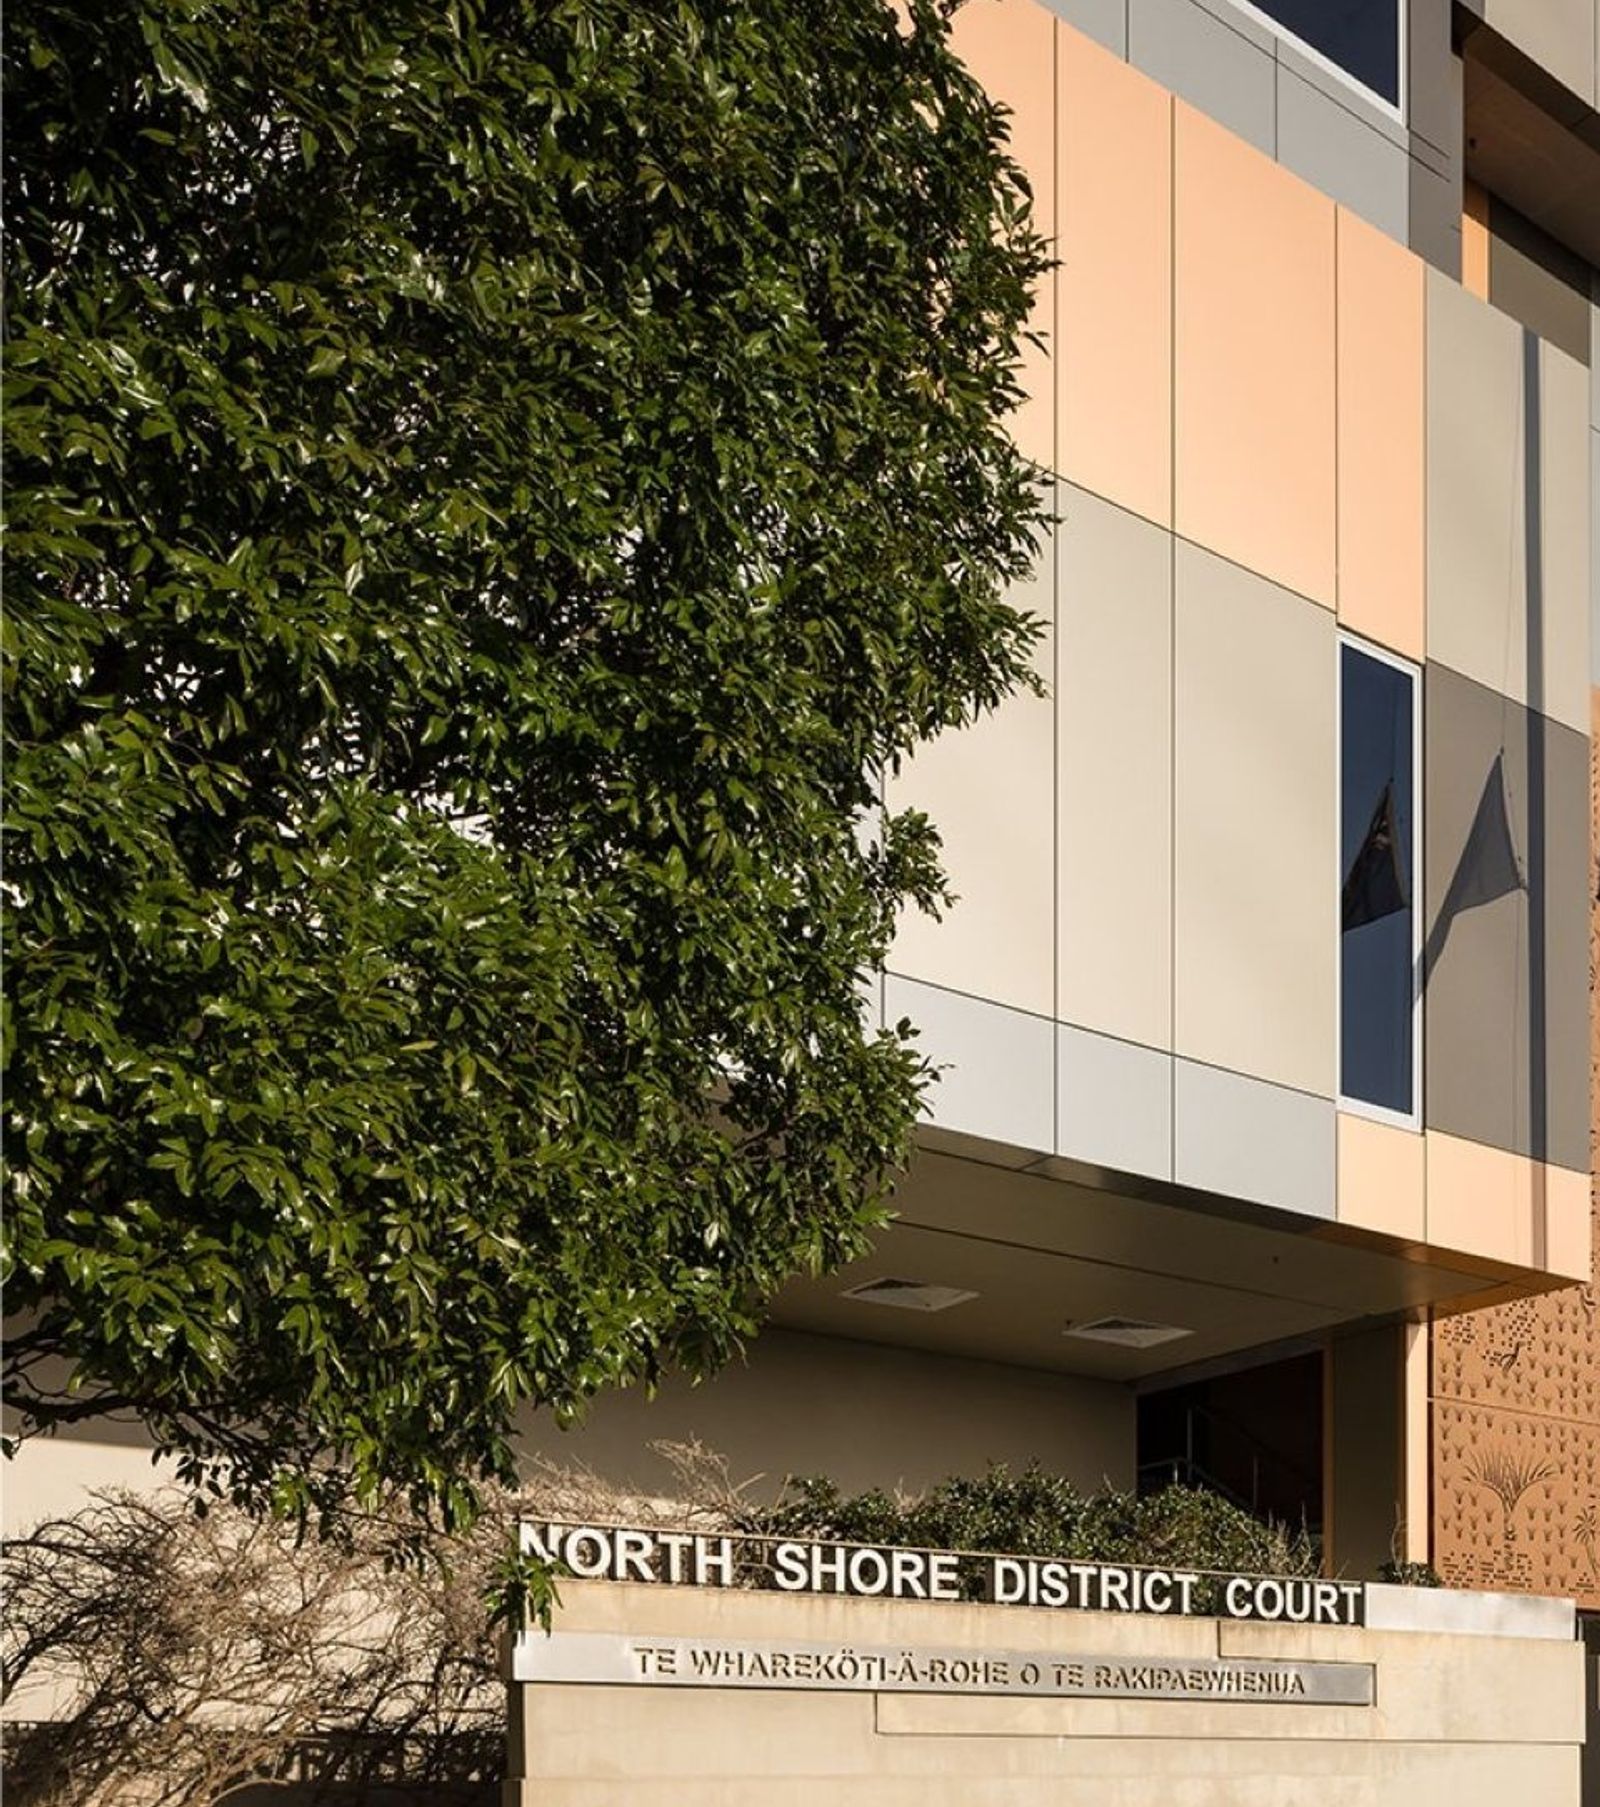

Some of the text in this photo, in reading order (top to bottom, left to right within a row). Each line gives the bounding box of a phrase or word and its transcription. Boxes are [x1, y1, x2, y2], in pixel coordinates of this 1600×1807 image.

[520, 1522, 1362, 1624] NORTH SHORE DISTRICT COURT
[633, 1648, 677, 1674] TE
[1020, 1662, 1040, 1686] O
[1051, 1664, 1085, 1688] TE
[1095, 1665, 1305, 1694] RAKIPAEWHENUA
